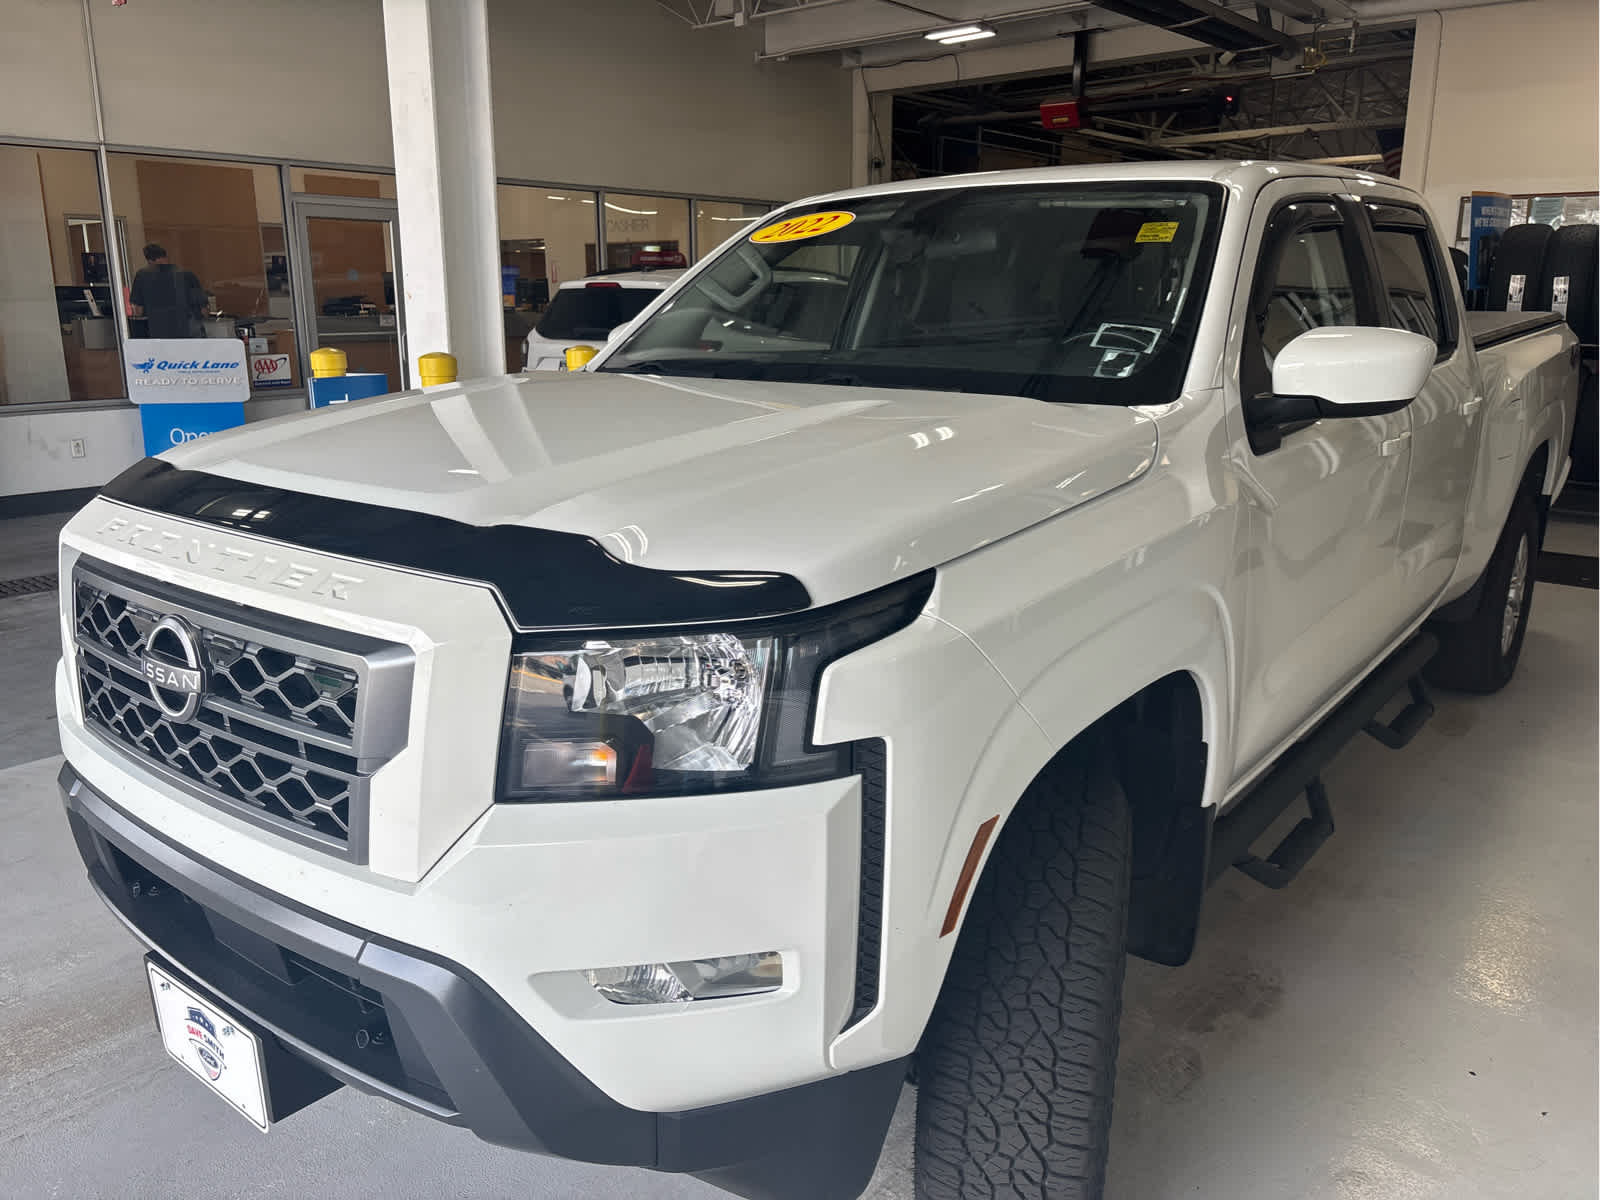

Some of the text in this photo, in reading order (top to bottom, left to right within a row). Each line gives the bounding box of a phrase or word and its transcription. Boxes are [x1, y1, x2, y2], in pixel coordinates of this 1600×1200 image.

[760, 215, 841, 237] 2022
[157, 360, 240, 371] Quick Lane
[254, 358, 278, 374] AAA
[135, 375, 179, 387] READY
[182, 375, 199, 386] TO
[200, 374, 242, 386] SERVE
[170, 427, 213, 445] Ope
[143, 660, 199, 690] ISSAN
